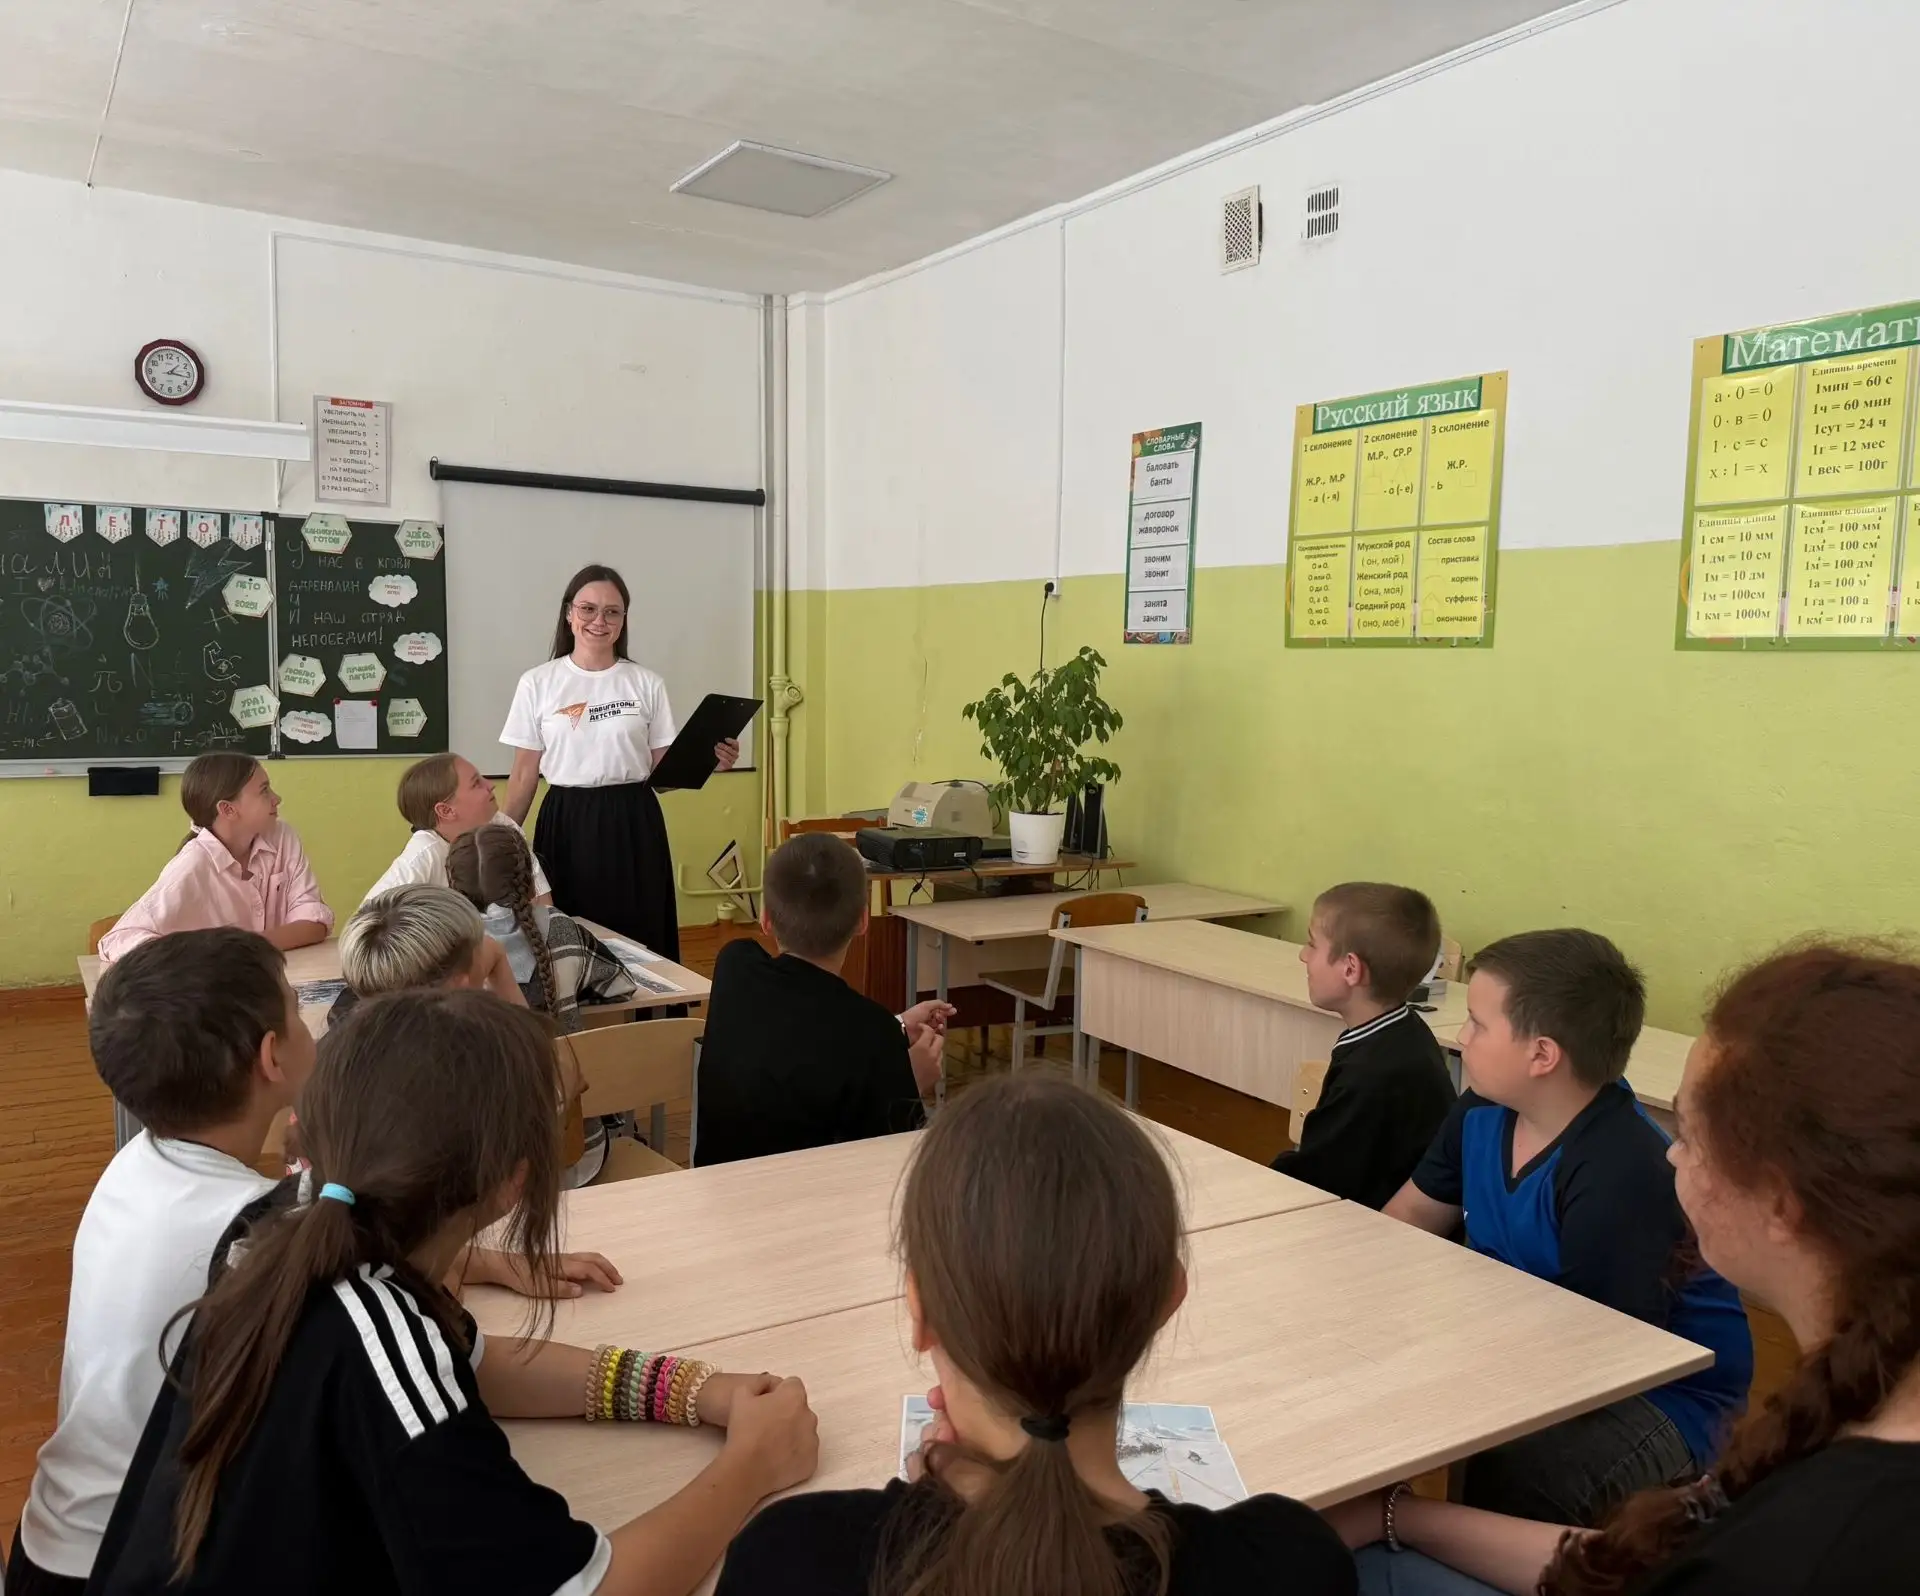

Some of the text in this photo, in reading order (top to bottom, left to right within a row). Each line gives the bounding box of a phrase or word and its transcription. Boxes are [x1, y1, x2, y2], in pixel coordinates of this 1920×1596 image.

[1727, 316, 1920, 369] Математ
[1812, 359, 1897, 376] Единицы времени
[1816, 375, 1892, 394] 1мин 60 с
[1813, 397, 1891, 414] 1ч 60 мин
[324, 409, 357, 417] УВЕЛИЧИТЬ
[1431, 420, 1490, 434] 3 склонение
[1815, 418, 1886, 436] 1сут 24 ч
[1146, 432, 1185, 445] СЛОВАРНЫЕ
[1364, 429, 1418, 443] 2 склонение
[1154, 442, 1175, 452] СЛОВА
[1310, 439, 1352, 451] склонение
[1813, 440, 1886, 455] 1г 12 мес
[1393, 447, 1412, 457] СР.Р
[1146, 462, 1179, 472] баловать
[1447, 460, 1467, 470] Ж.Р.
[1818, 465, 1841, 475] век
[1859, 459, 1888, 471] 100г
[1150, 478, 1172, 486] банты
[1329, 473, 1346, 483] М.Р
[1144, 510, 1175, 521] договор
[1801, 510, 1842, 518] Единицы
[1699, 518, 1740, 527] Единицы
[1840, 522, 1858, 532] 100
[405, 530, 432, 539] ЗДЕСЬ
[1138, 525, 1179, 535] жаворонок
[1428, 537, 1452, 545] Состав
[1710, 536, 1724, 544] см
[1740, 531, 1751, 542] 10
[1756, 532, 1774, 540] мм
[404, 540, 435, 549] СУПЕР!
[1357, 540, 1410, 552] Мужской род
[1840, 540, 1859, 551] 100
[286, 540, 304, 569] У
[318, 556, 343, 568] НАС
[1144, 555, 1171, 563] звоним
[1709, 555, 1725, 564] дм
[1741, 550, 1752, 561] 10
[1756, 552, 1771, 560] см
[1441, 556, 1479, 565] приставка
[1835, 559, 1853, 569] 100
[1145, 570, 1169, 578] звонит
[1357, 571, 1408, 580] Женский род
[1705, 570, 1765, 582] 1м 10 дм
[236, 581, 260, 590] ЛЕТО
[1451, 576, 1478, 584] корень
[1809, 577, 1854, 588] 1а 100
[288, 580, 360, 593] АДРЕНАЛИН
[1445, 595, 1478, 604] суффикс
[1703, 589, 1765, 601] 1м 100см
[1144, 600, 1167, 608] занята
[1355, 601, 1405, 612] Средний род
[1812, 598, 1824, 606] га
[1840, 596, 1859, 606] 100
[313, 612, 345, 624] НАШ
[1705, 612, 1720, 620] км
[1736, 608, 1770, 619] 1000м
[1838, 615, 1856, 624] 100
[1860, 616, 1872, 624] га
[241, 696, 264, 707] УРА!
[240, 705, 271, 719] ЛЕТО!
[589, 702, 634, 714] НАВИГАТОРЫ
[590, 710, 621, 720] ДЕТСТВА
